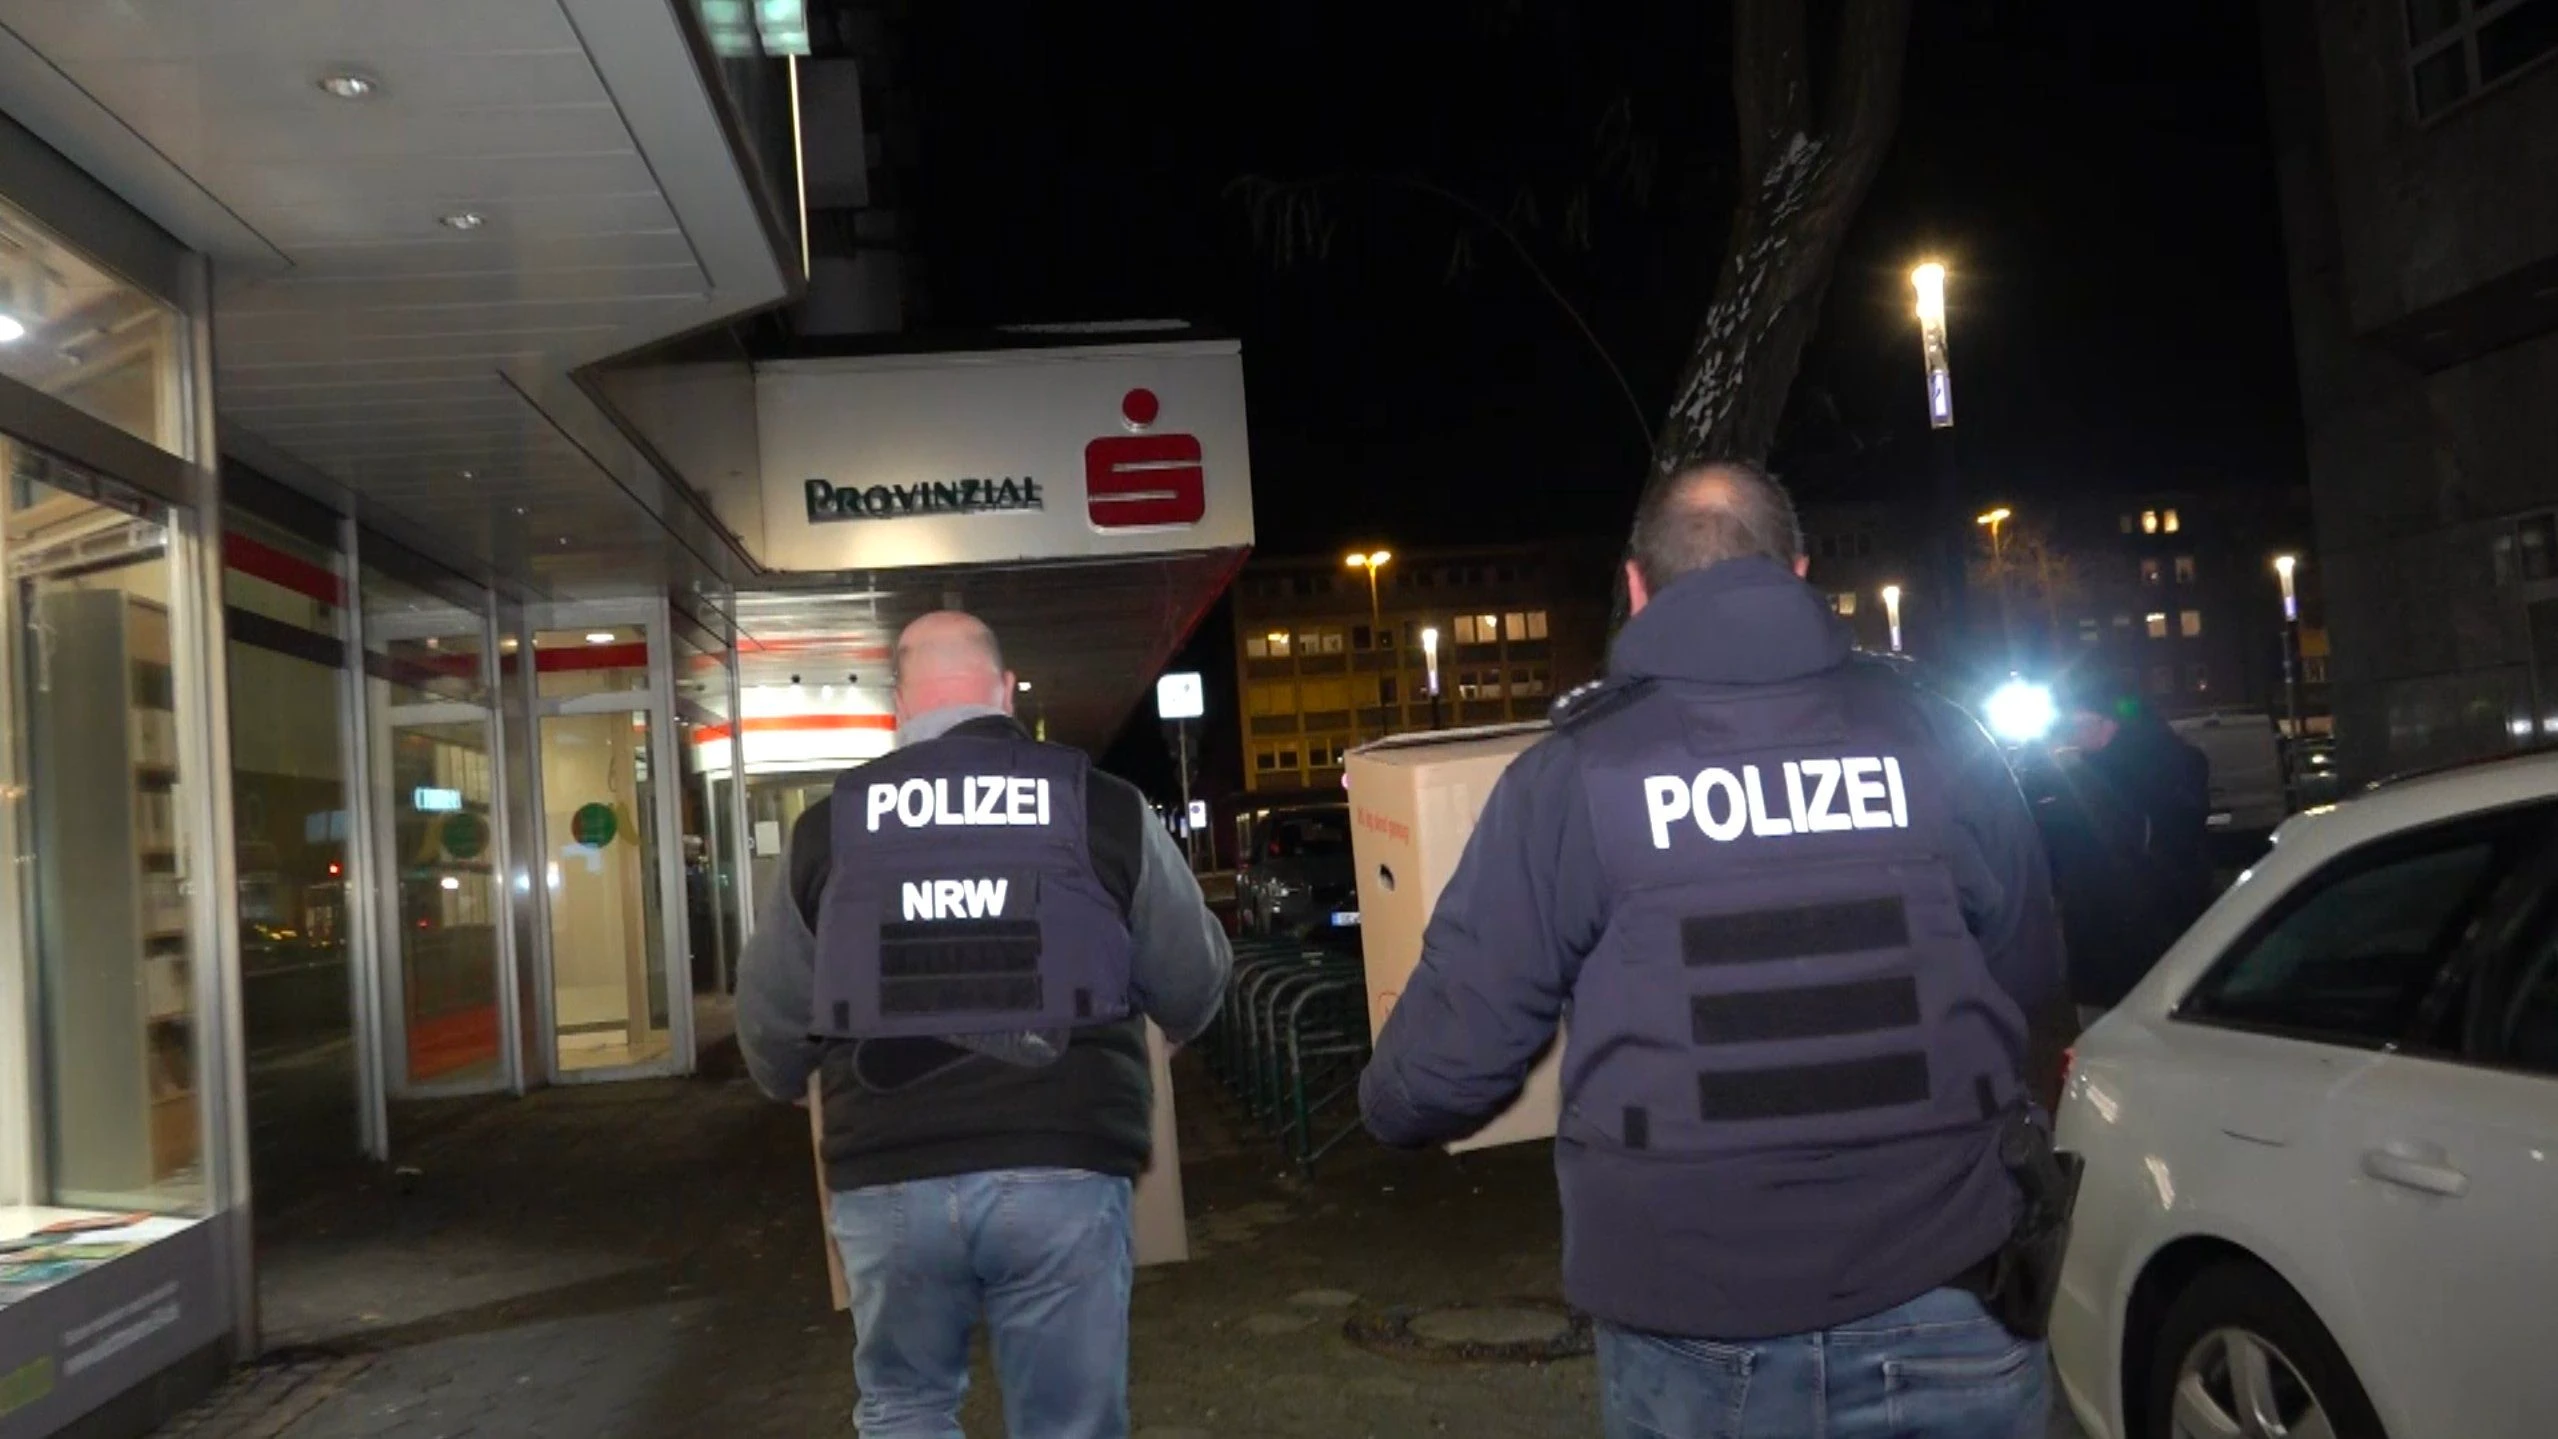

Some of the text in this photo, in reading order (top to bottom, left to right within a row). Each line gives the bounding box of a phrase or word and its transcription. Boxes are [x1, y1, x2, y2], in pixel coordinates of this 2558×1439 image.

[804, 476, 1043, 524] PROVINZIAL
[866, 775, 1051, 833] POLIZEI
[1643, 756, 1909, 850] POLIZEI
[902, 878, 1009, 922] NRW
